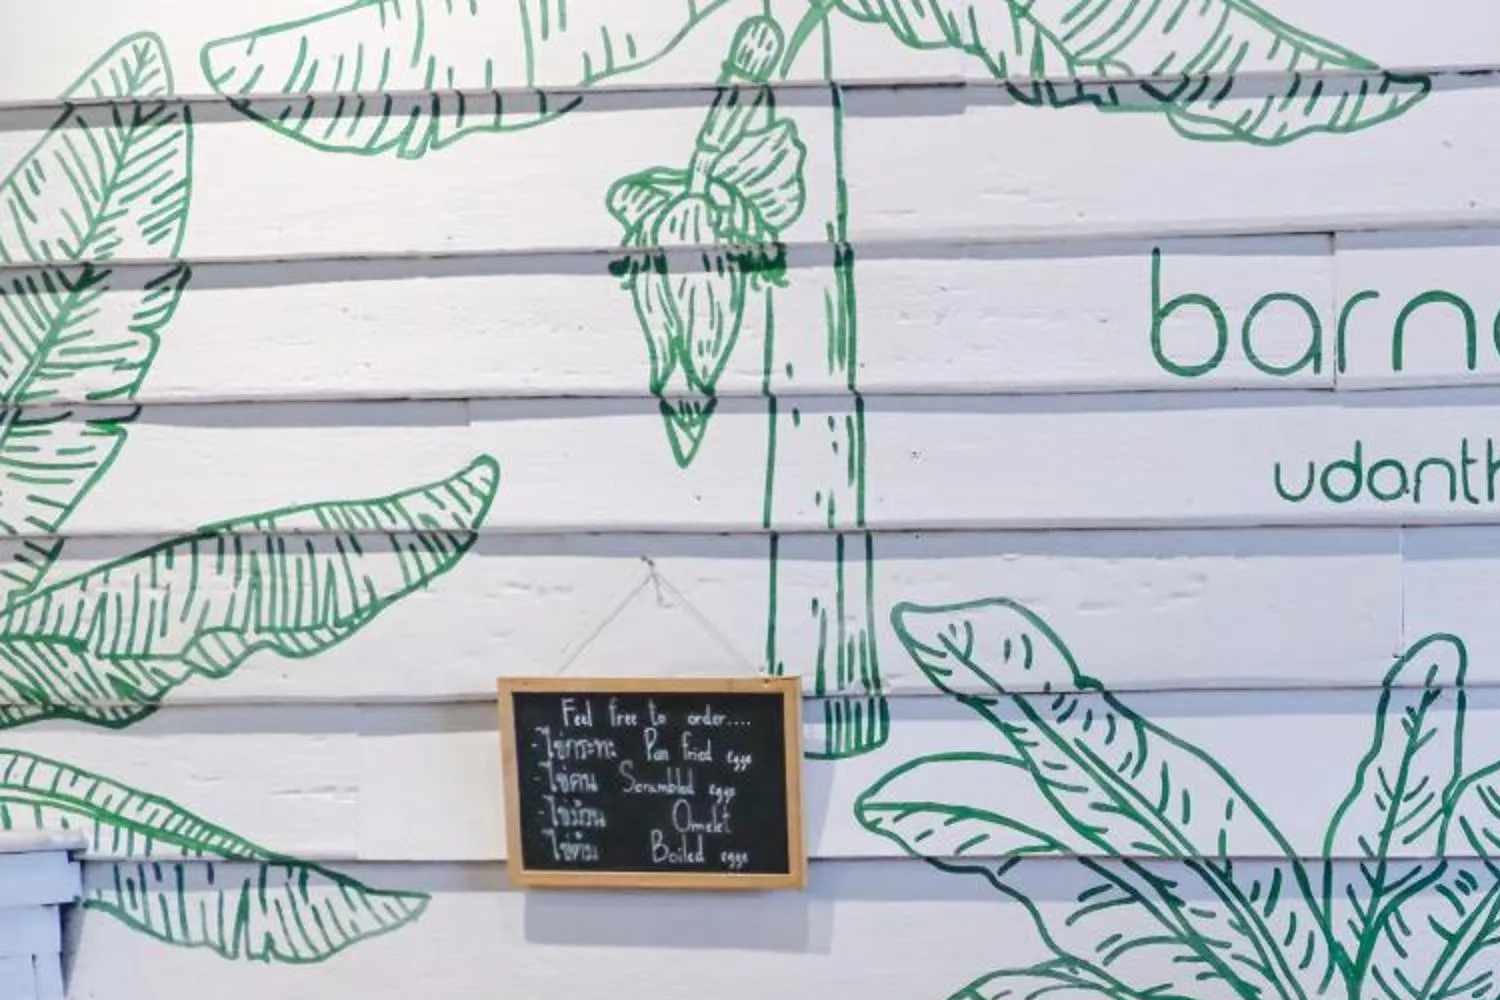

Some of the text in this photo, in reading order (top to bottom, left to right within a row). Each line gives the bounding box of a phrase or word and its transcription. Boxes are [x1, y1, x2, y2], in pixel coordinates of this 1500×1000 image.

[561, 698, 593, 727] Feel
[609, 697, 638, 725] free
[649, 698, 667, 726] to
[644, 727, 669, 761] Pan
[681, 731, 713, 761] fried
[651, 829, 705, 863] Boiled
